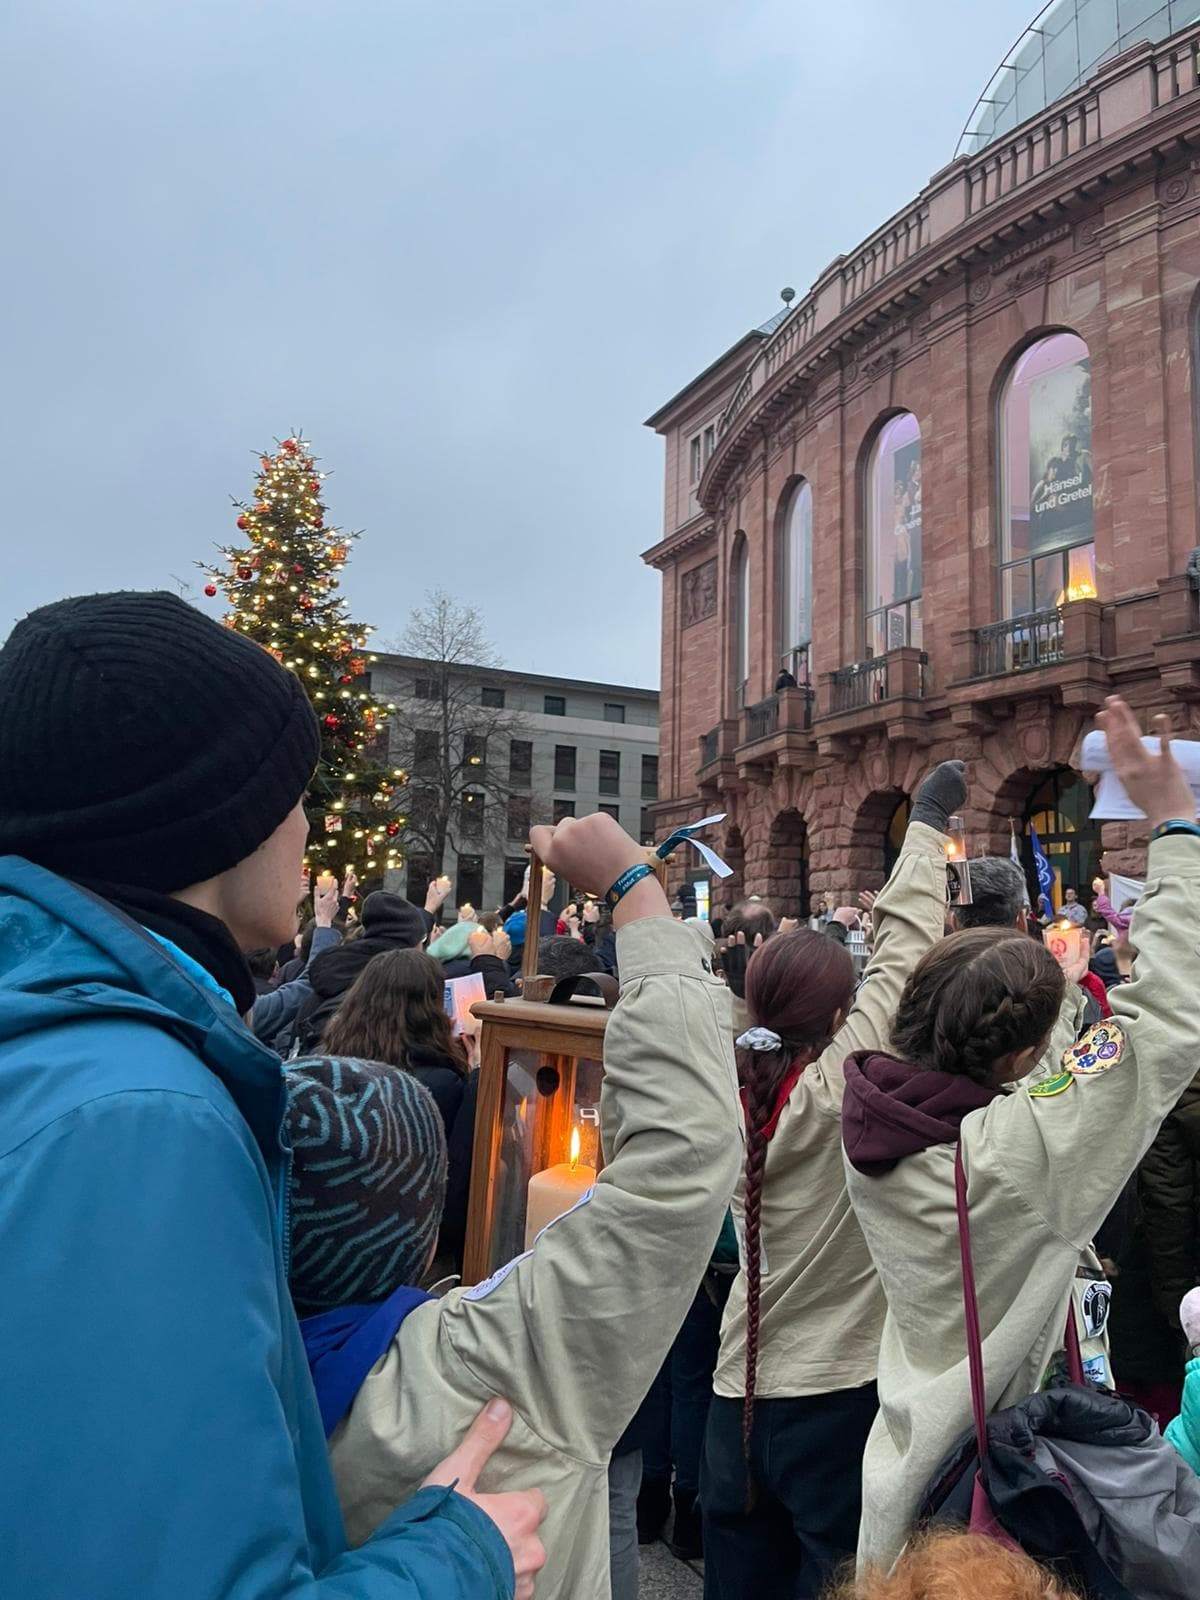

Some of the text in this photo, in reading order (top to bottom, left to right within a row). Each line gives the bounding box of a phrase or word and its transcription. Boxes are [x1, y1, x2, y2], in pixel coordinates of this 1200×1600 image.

[1044, 472, 1082, 493] Hänsel
[1035, 484, 1092, 512] und Gretel
